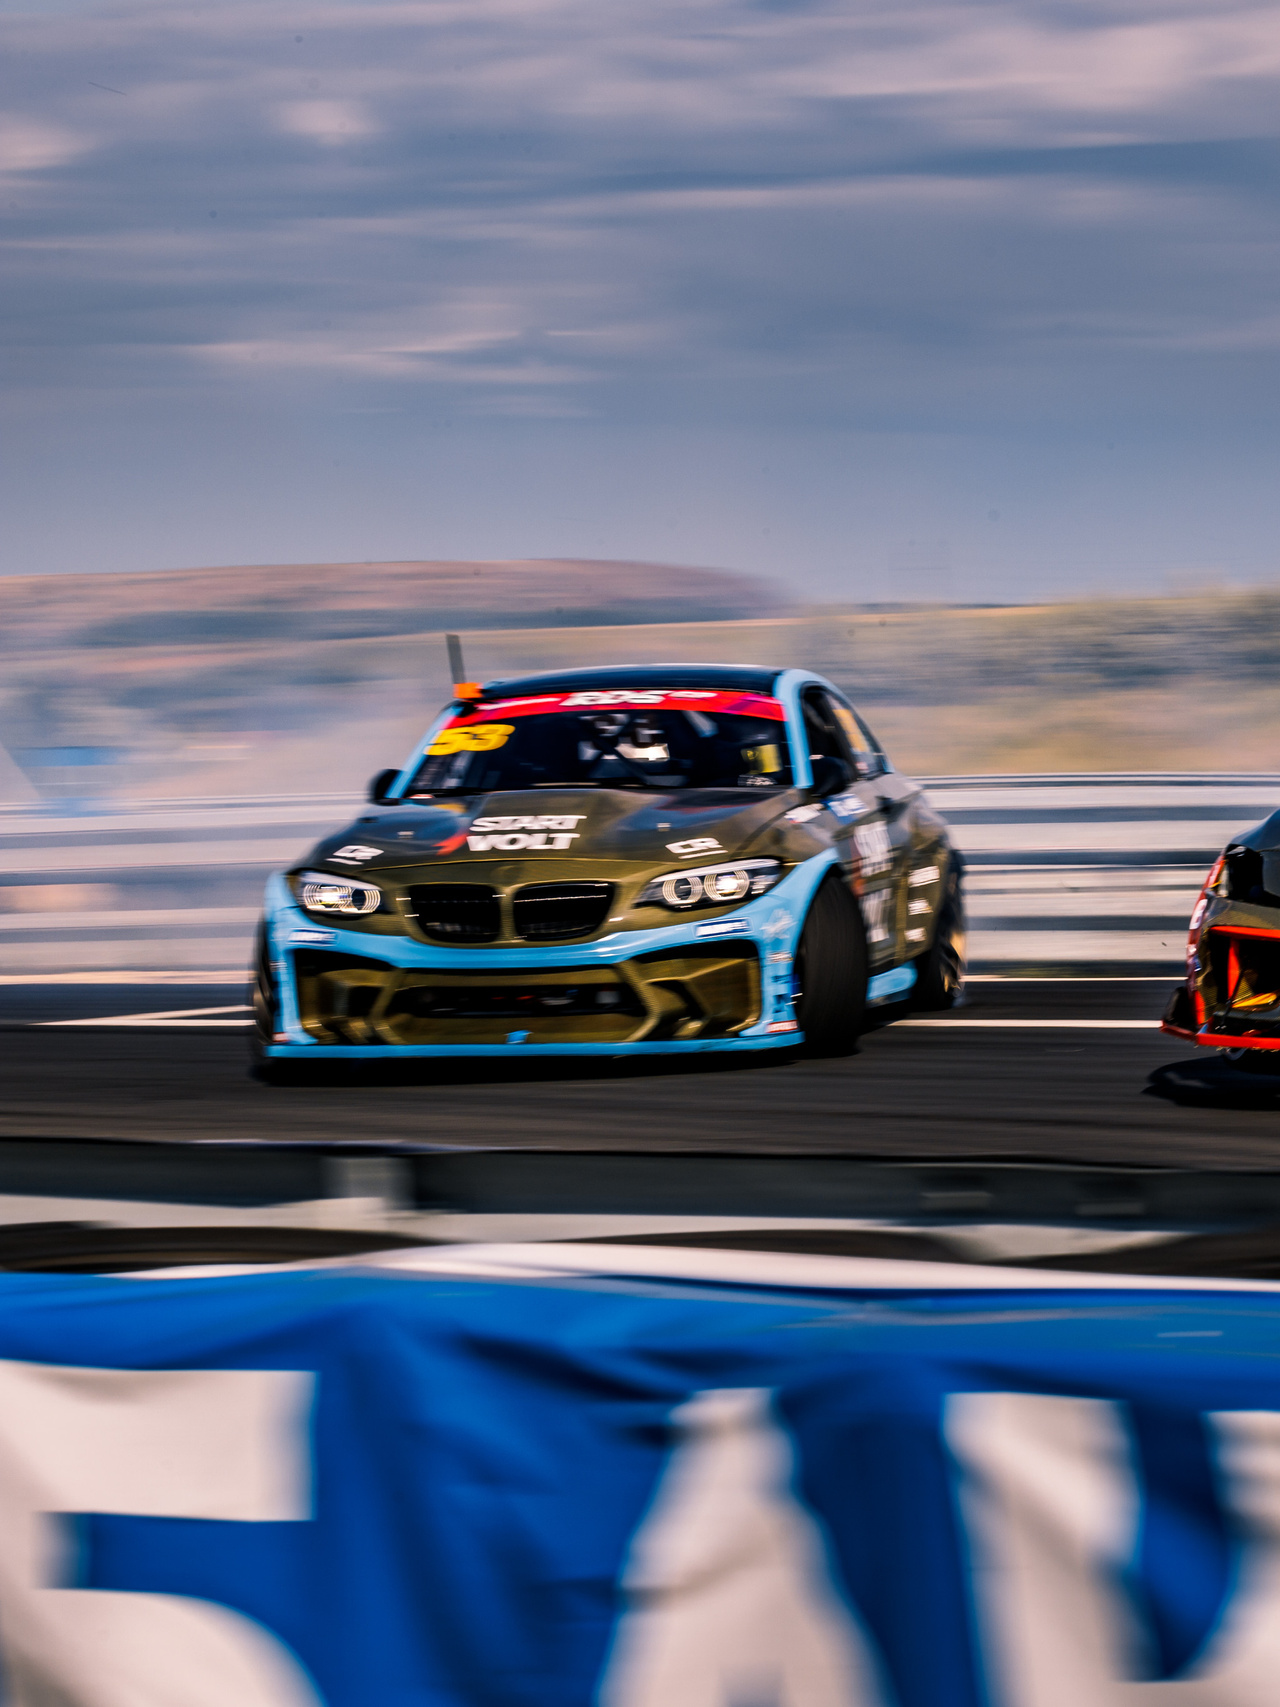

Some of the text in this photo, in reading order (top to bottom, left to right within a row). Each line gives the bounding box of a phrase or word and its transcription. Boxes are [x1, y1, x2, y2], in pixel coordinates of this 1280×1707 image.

[423, 724, 515, 755] 53
[469, 815, 588, 831] START
[466, 833, 581, 851] VOLT
